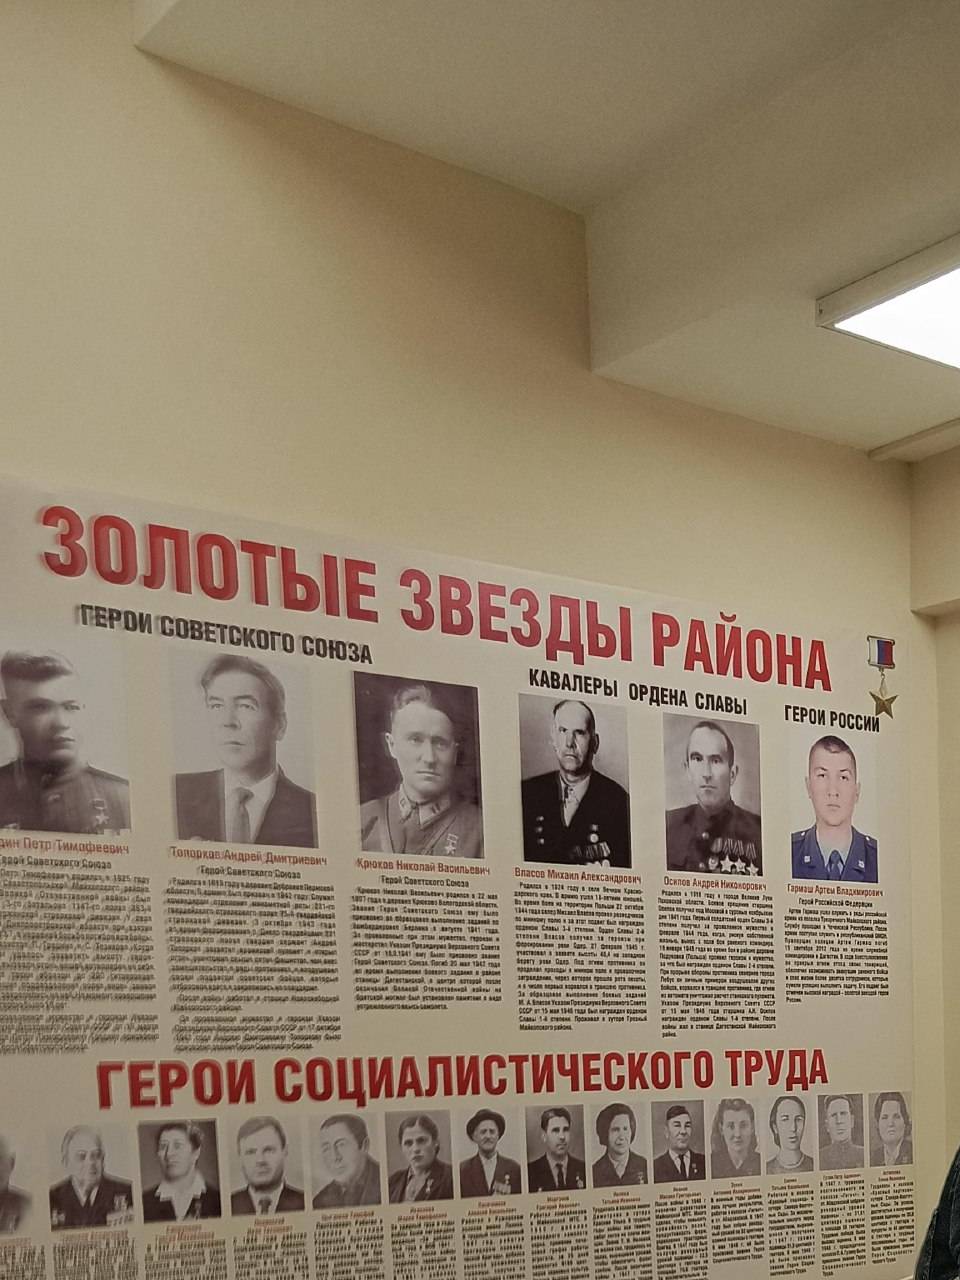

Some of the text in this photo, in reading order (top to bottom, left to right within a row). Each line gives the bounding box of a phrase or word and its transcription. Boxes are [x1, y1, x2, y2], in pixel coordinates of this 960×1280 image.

[41, 505, 832, 692] ЗОЛОТЫЕ ЗВЕЗДЫ РАЙОНА
[78, 604, 372, 664] ГЕРОИ СОВЕТСКОГО СОЮЗА
[529, 668, 747, 715] КАВАЛЕРЫ ОРДЕНА СЛАВЫ
[784, 705, 879, 732] ГЕРОИ РОССИИ
[356, 857, 490, 875] Крюков Николай Васильевич
[514, 867, 641, 884] Власов Михаил Александрович
[663, 875, 690, 886] Осипов
[692, 878, 719, 889] Андрей
[787, 883, 883, 897] Гармаш Артем Владимирович
[95, 1049, 829, 1110] ГЕРОИ СОЦИАЛИСТИЧЕСКОГО ТРУДА
